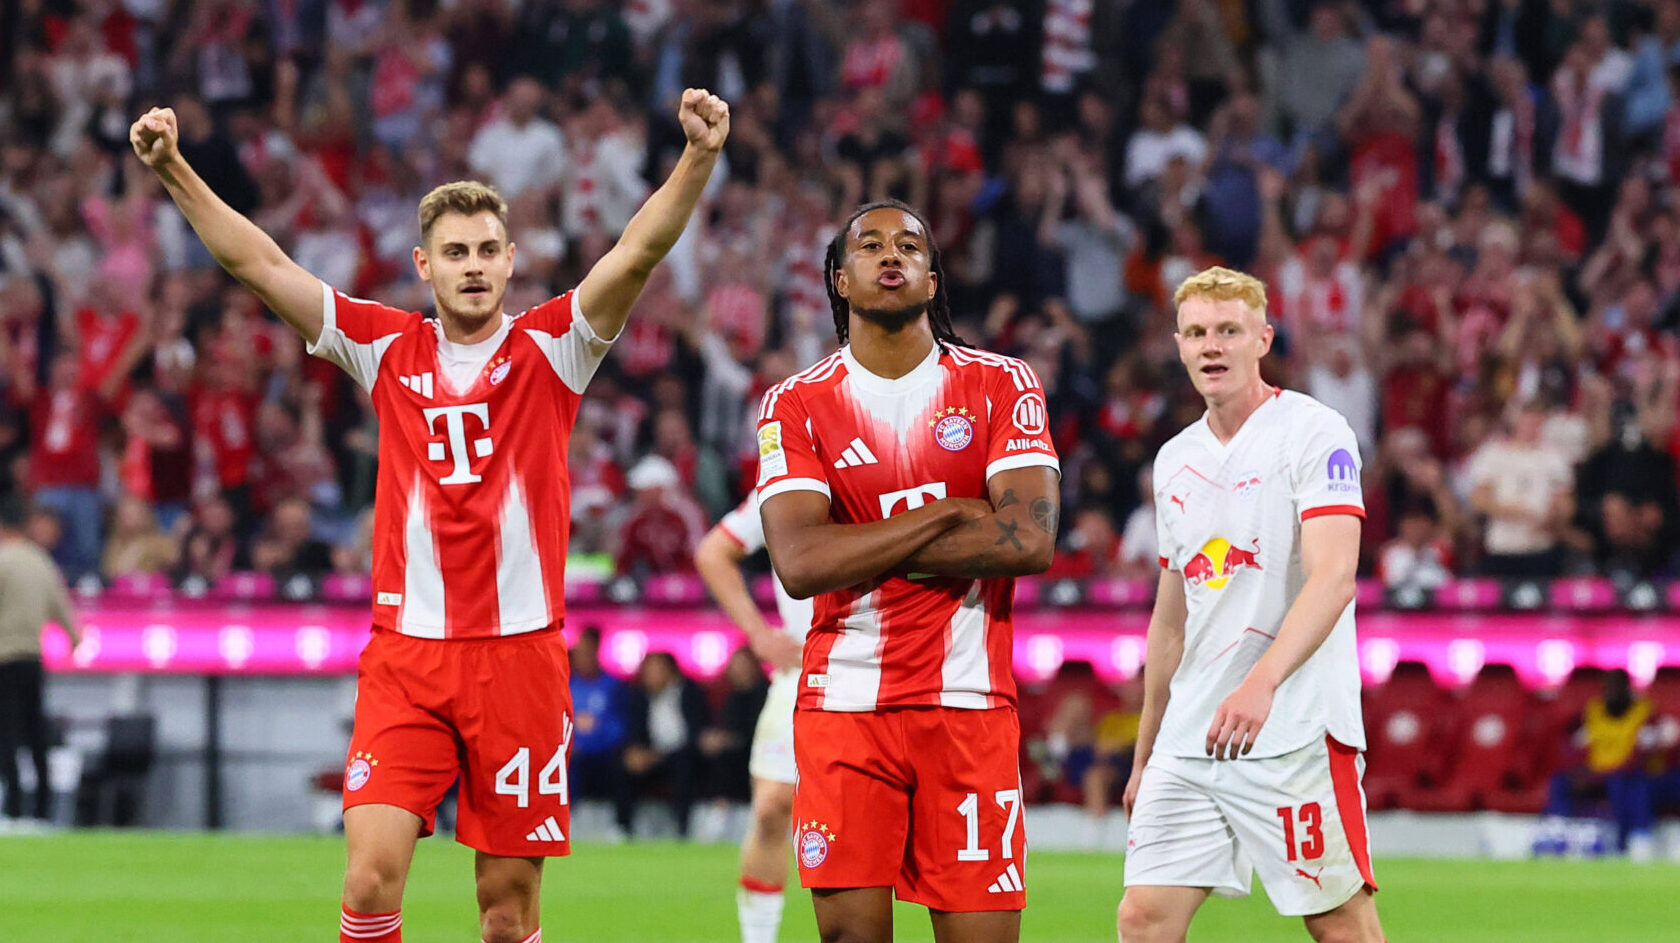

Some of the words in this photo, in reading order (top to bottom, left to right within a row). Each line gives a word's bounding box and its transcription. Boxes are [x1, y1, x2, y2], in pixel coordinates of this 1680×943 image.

[422, 402, 494, 485] T
[944, 417, 969, 430] BAYERN
[495, 744, 569, 808] 44
[957, 789, 1020, 861] 17
[1276, 801, 1325, 862] 13
